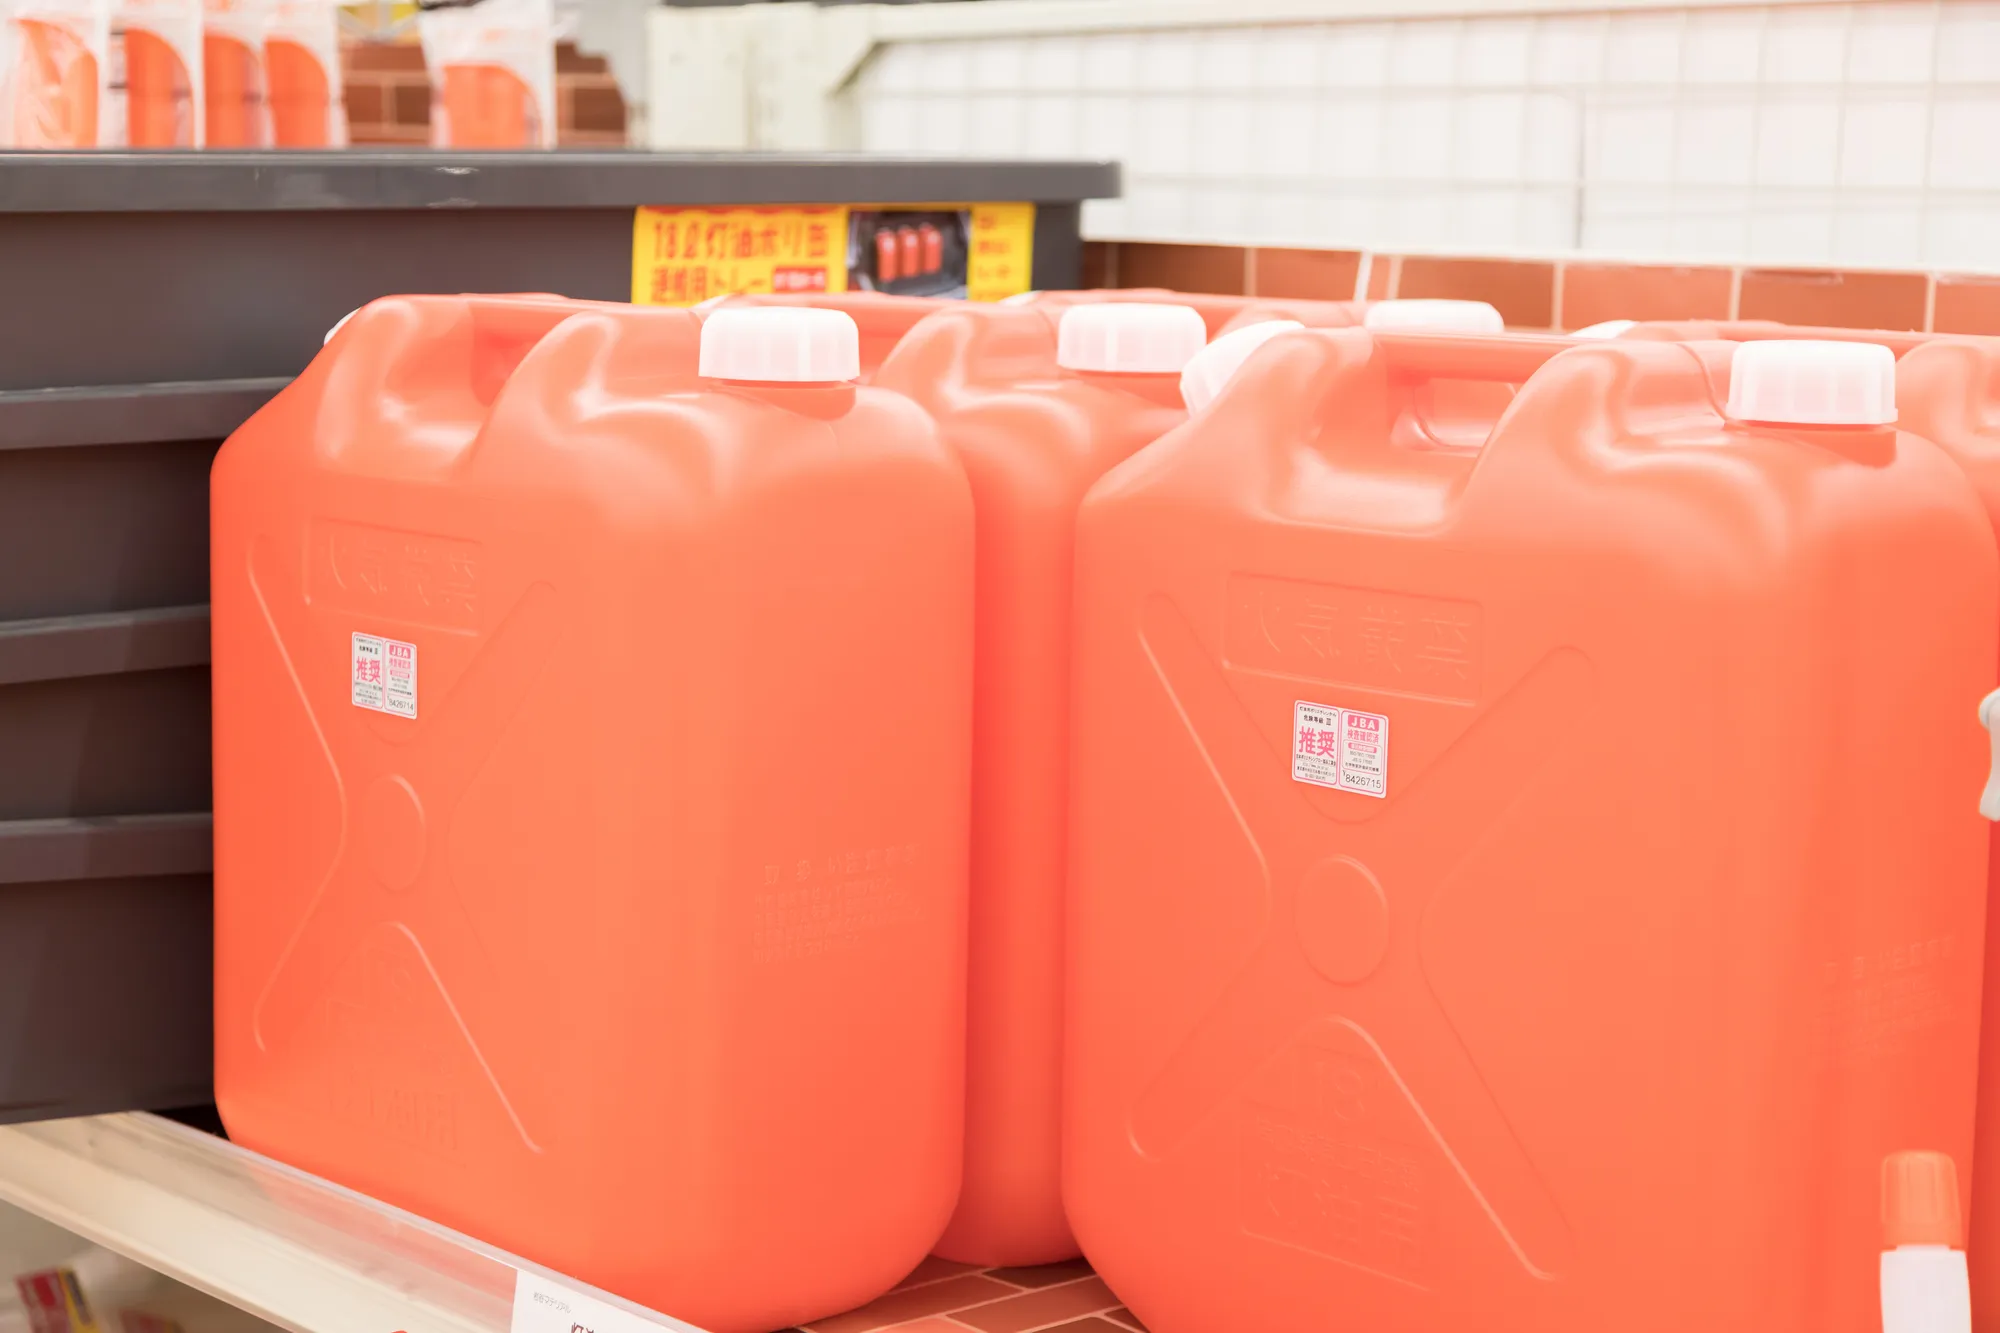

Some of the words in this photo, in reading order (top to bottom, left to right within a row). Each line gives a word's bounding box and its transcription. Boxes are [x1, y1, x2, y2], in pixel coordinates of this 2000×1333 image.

[391, 646, 408, 657] JBA
[357, 657, 380, 684] 推奨
[1351, 717, 1375, 729] JBA
[1299, 726, 1334, 758] 推奨
[1345, 774, 1381, 788] 8426715
